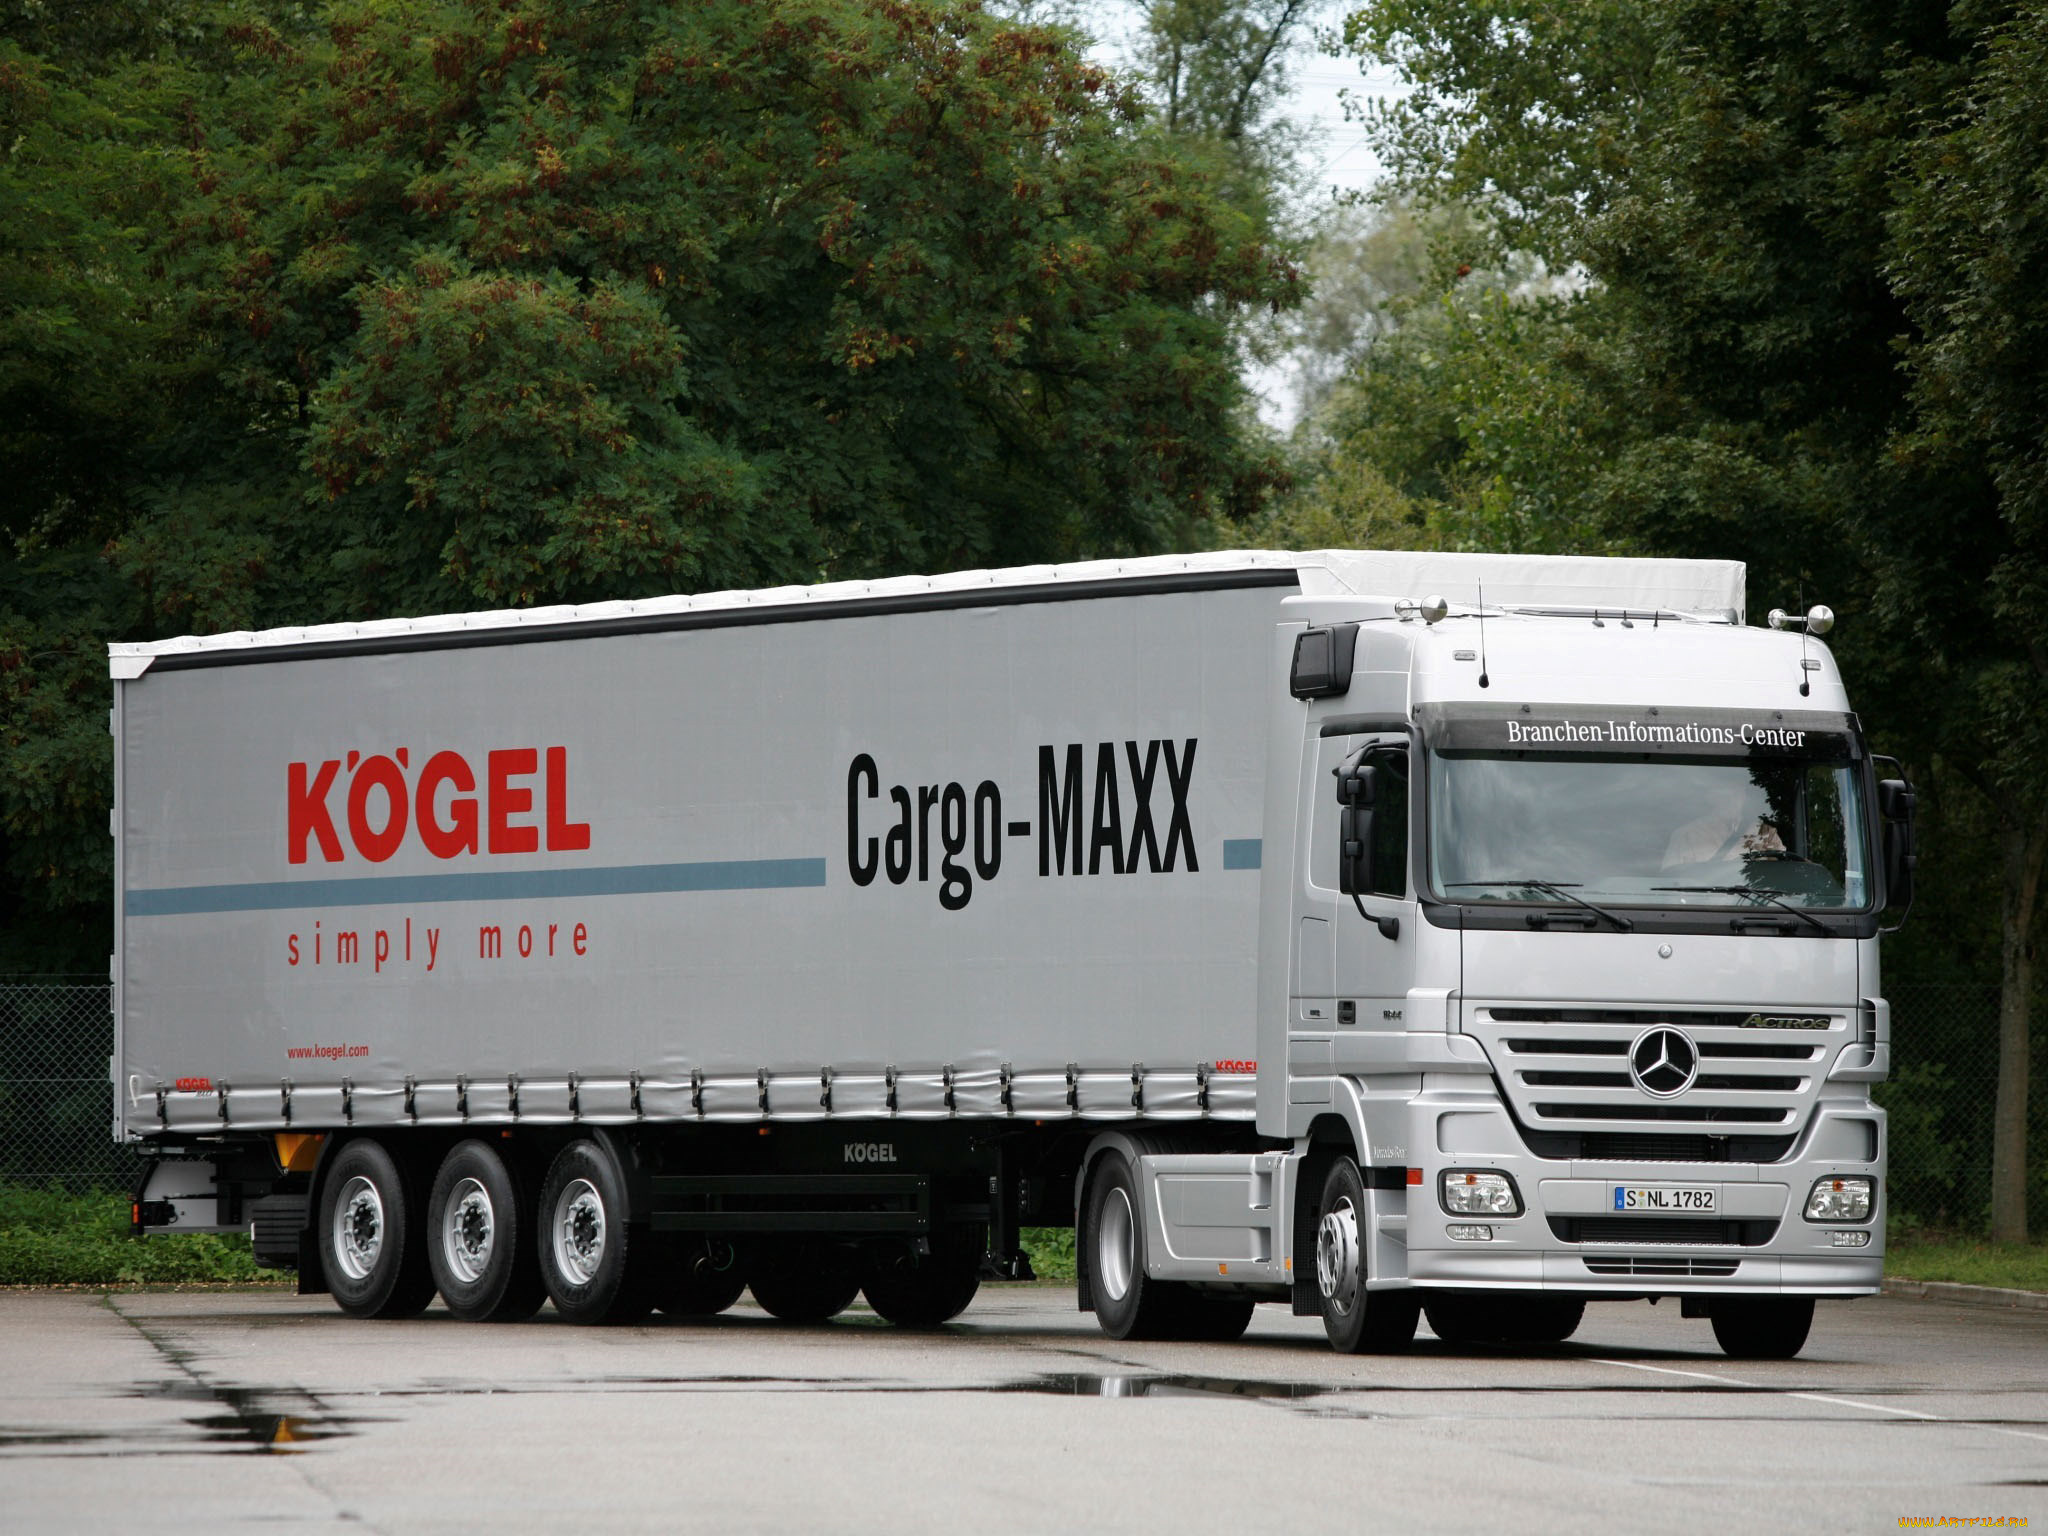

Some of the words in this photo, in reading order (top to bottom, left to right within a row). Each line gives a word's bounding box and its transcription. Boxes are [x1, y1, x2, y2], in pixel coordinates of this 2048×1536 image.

[1507, 720, 1806, 747] Branchen-Informations-Center
[287, 746, 591, 864] KÖGEL
[847, 738, 1200, 911] Cargo-MAXX
[287, 917, 440, 973] simply
[479, 921, 588, 959] more
[287, 1043, 369, 1061] www.koegel.com
[844, 1142, 897, 1162] KÖGEL
[1626, 1190, 1636, 1207] S
[1648, 1191, 1669, 1208] NL
[1673, 1191, 1713, 1208] 1782
